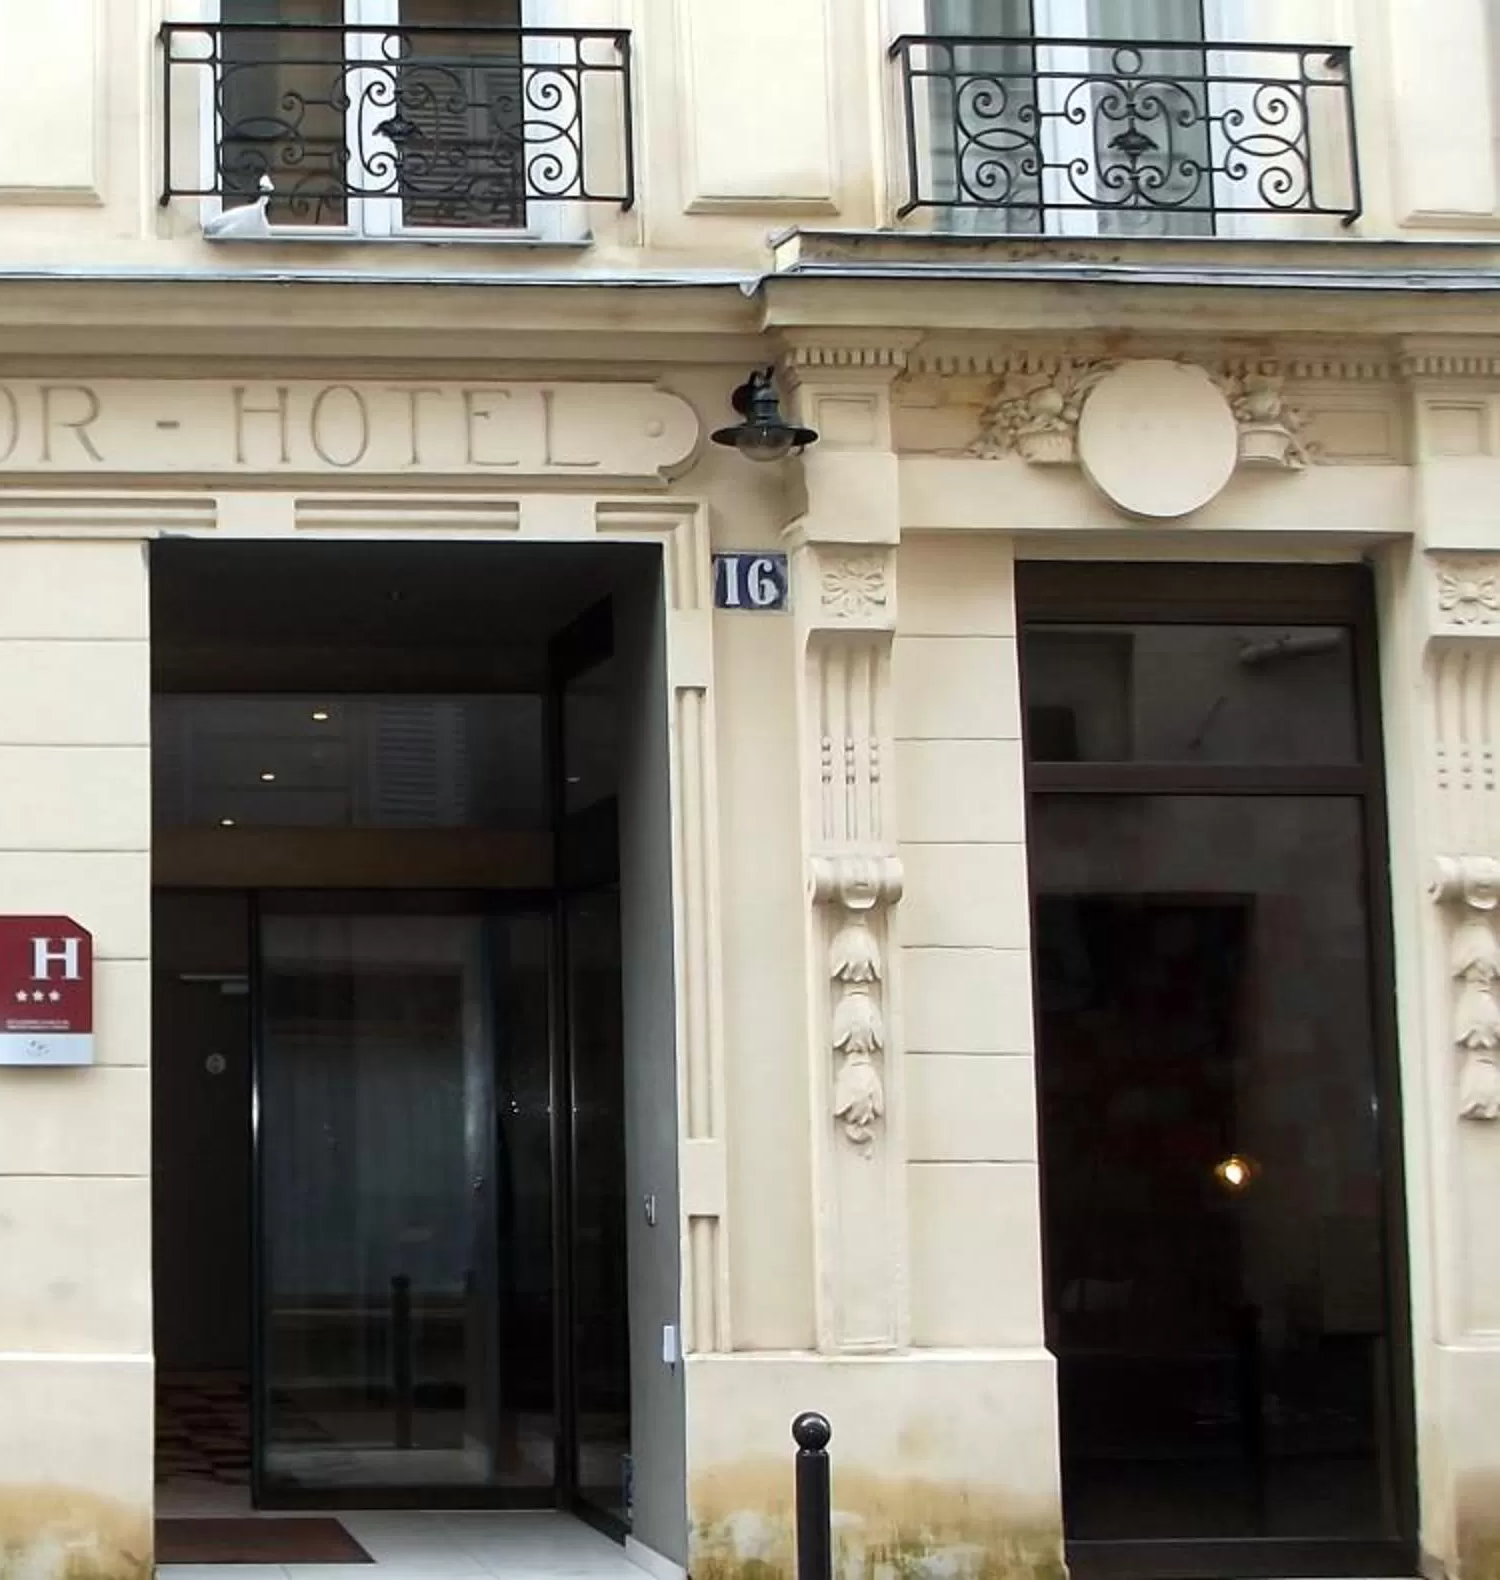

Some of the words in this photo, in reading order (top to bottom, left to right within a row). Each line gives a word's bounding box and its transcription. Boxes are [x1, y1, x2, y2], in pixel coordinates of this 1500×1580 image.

[231, 384, 600, 468] HOTEL
[724, 558, 779, 605] 16
[30, 937, 83, 980] H
